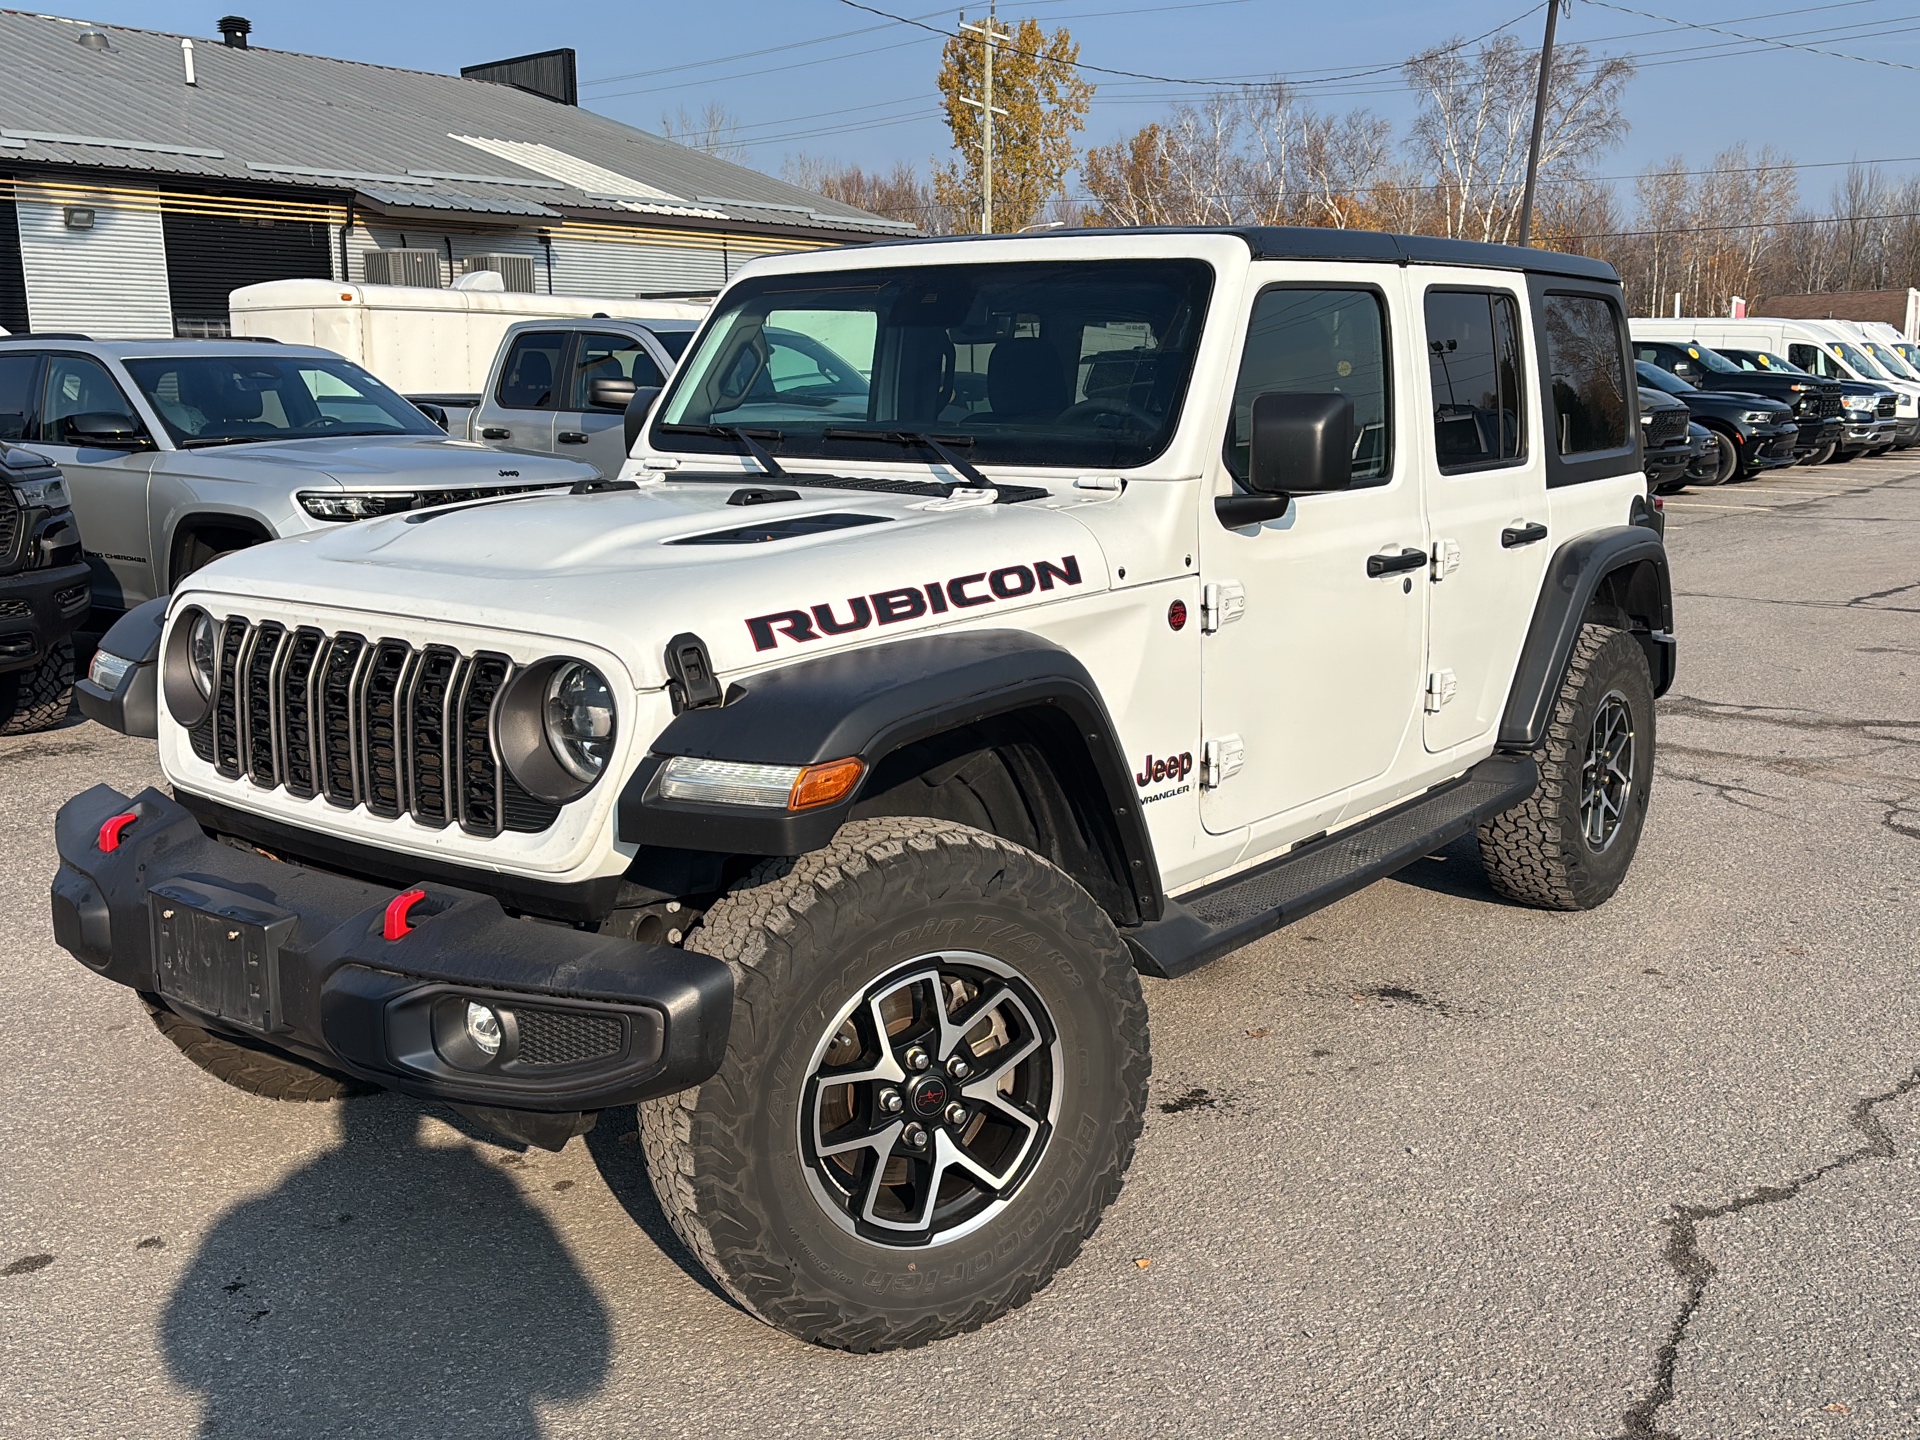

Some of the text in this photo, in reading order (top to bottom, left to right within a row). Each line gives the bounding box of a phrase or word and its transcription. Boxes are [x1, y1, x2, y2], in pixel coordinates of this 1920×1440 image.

[498, 469, 520, 478] Jeep
[105, 553, 147, 563] CHEROKEE
[744, 554, 1083, 652] RUBICON
[1136, 751, 1193, 788] Jeep
[972, 914, 1046, 953] T/A
[862, 1112, 1100, 1294] BFGoodrich
